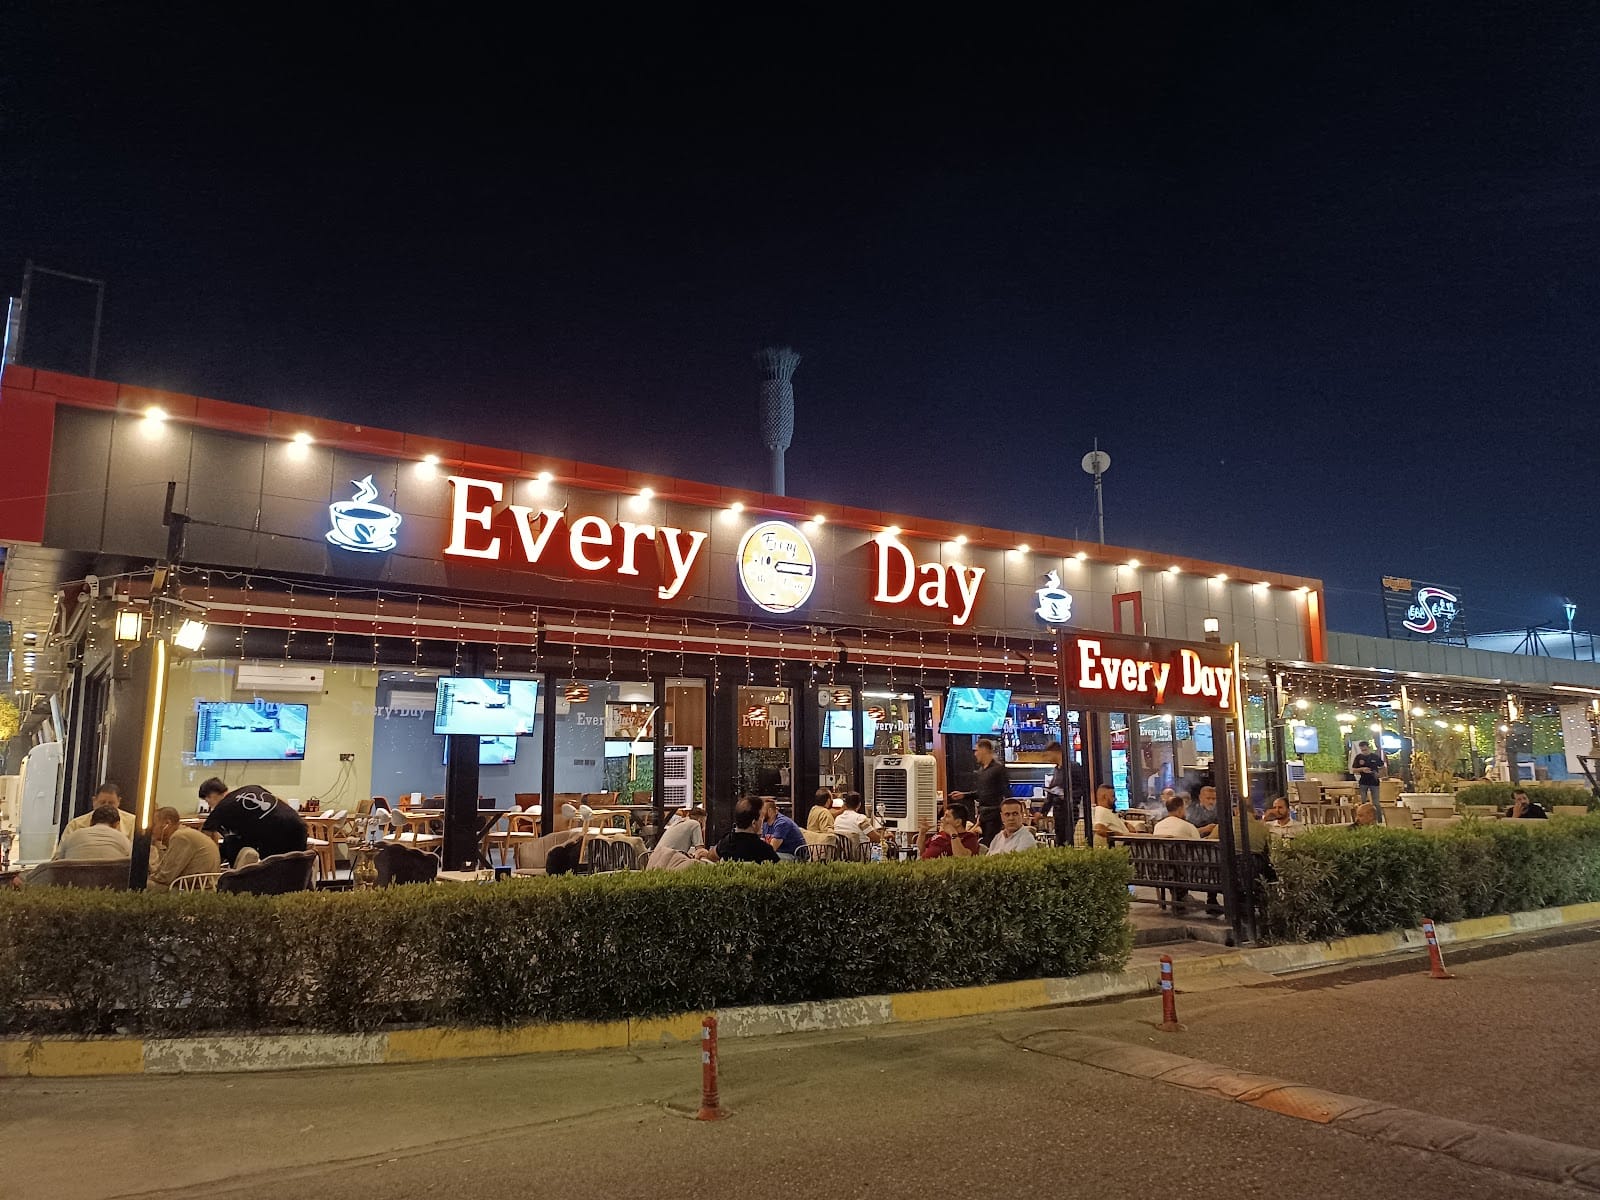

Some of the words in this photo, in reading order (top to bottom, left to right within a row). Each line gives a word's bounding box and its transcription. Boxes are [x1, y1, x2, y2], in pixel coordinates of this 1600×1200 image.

[443, 475, 709, 601] Every
[872, 533, 987, 627] Day
[1077, 638, 1171, 705] Every
[1180, 648, 1234, 709] Day
[253, 697, 281, 719] Day
[399, 703, 426, 721] Day
[576, 711, 611, 727] Ever
[742, 714, 770, 730] Every
[771, 715, 791, 731] Day
[874, 721, 893, 734] very
[897, 719, 915, 734] Day
[1043, 723, 1062, 735] Ever
[1139, 726, 1157, 739] Every
